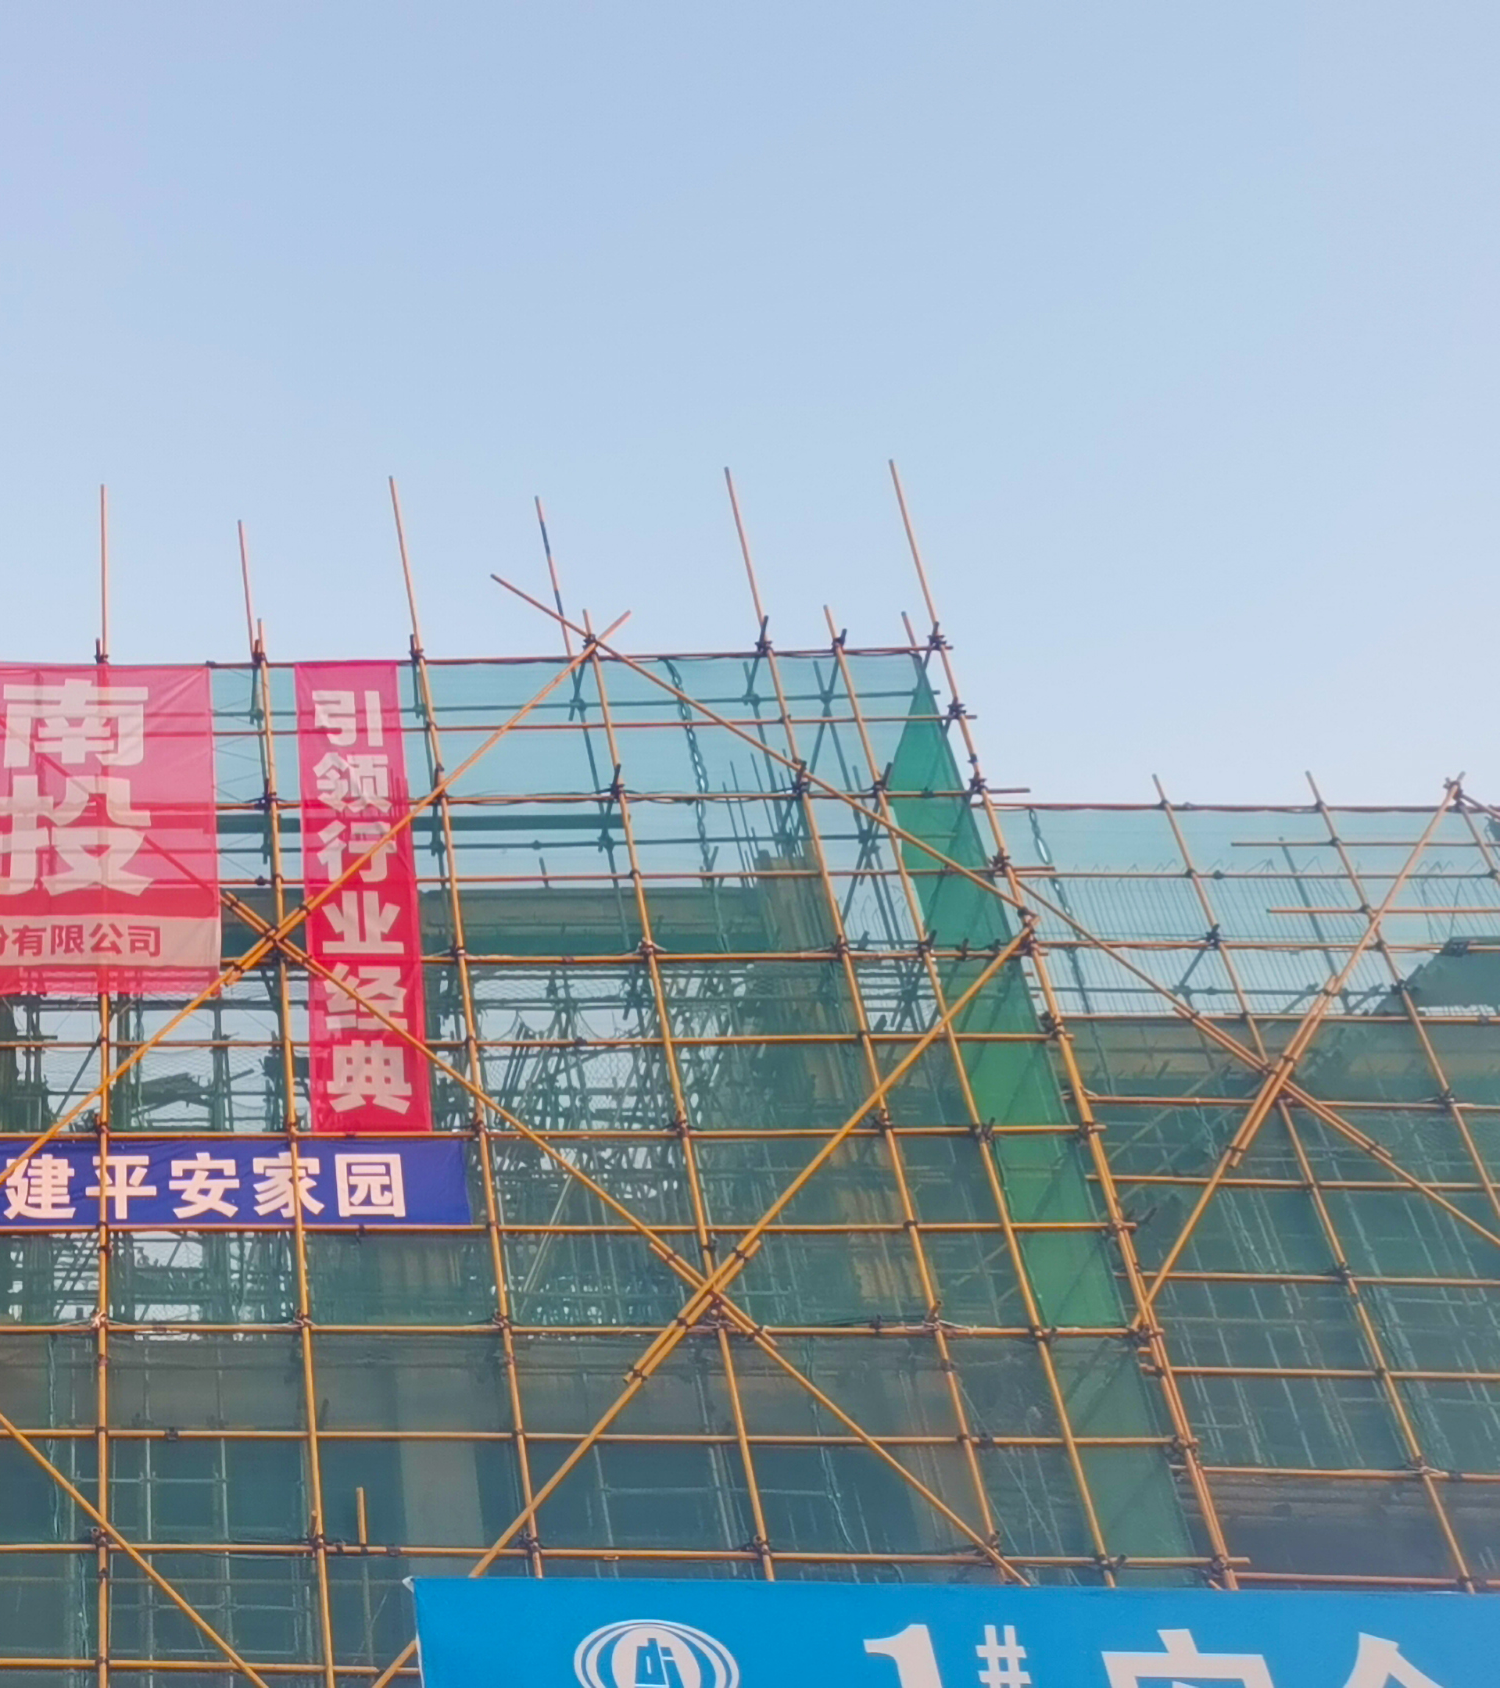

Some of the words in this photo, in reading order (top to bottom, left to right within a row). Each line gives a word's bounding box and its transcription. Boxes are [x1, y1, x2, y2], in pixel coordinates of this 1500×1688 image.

[312, 689, 412, 1116] 引领行业经典
